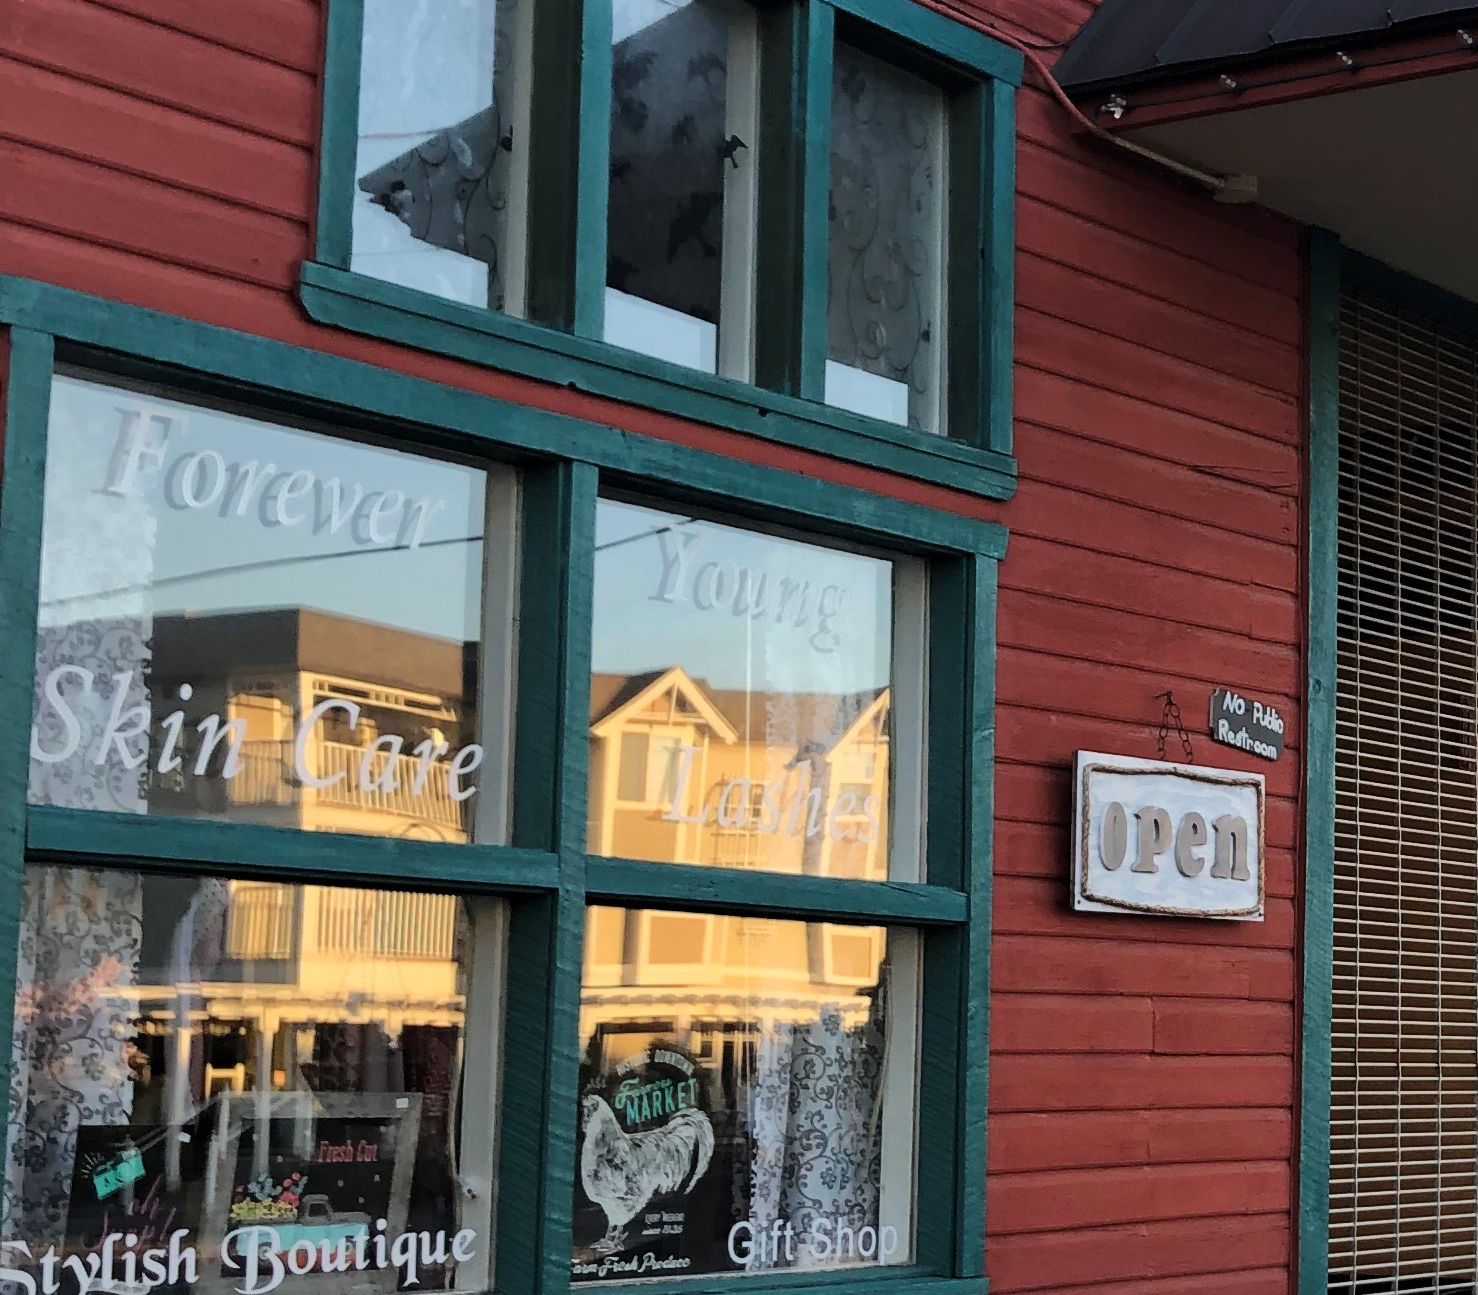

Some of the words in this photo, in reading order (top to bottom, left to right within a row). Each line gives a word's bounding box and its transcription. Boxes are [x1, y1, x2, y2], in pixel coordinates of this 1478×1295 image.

[100, 407, 445, 549] Forever
[652, 521, 852, 653] Young
[29, 664, 247, 781] Skin
[294, 698, 484, 802] Care
[1217, 718, 1278, 761] Restroom
[1252, 701, 1284, 736] Public
[662, 744, 881, 845] Lashes
[626, 1077, 697, 1127] MARKET
[220, 1217, 478, 1295] Boutique
[727, 1218, 796, 1268] Gift
[809, 1217, 899, 1267] Shop
